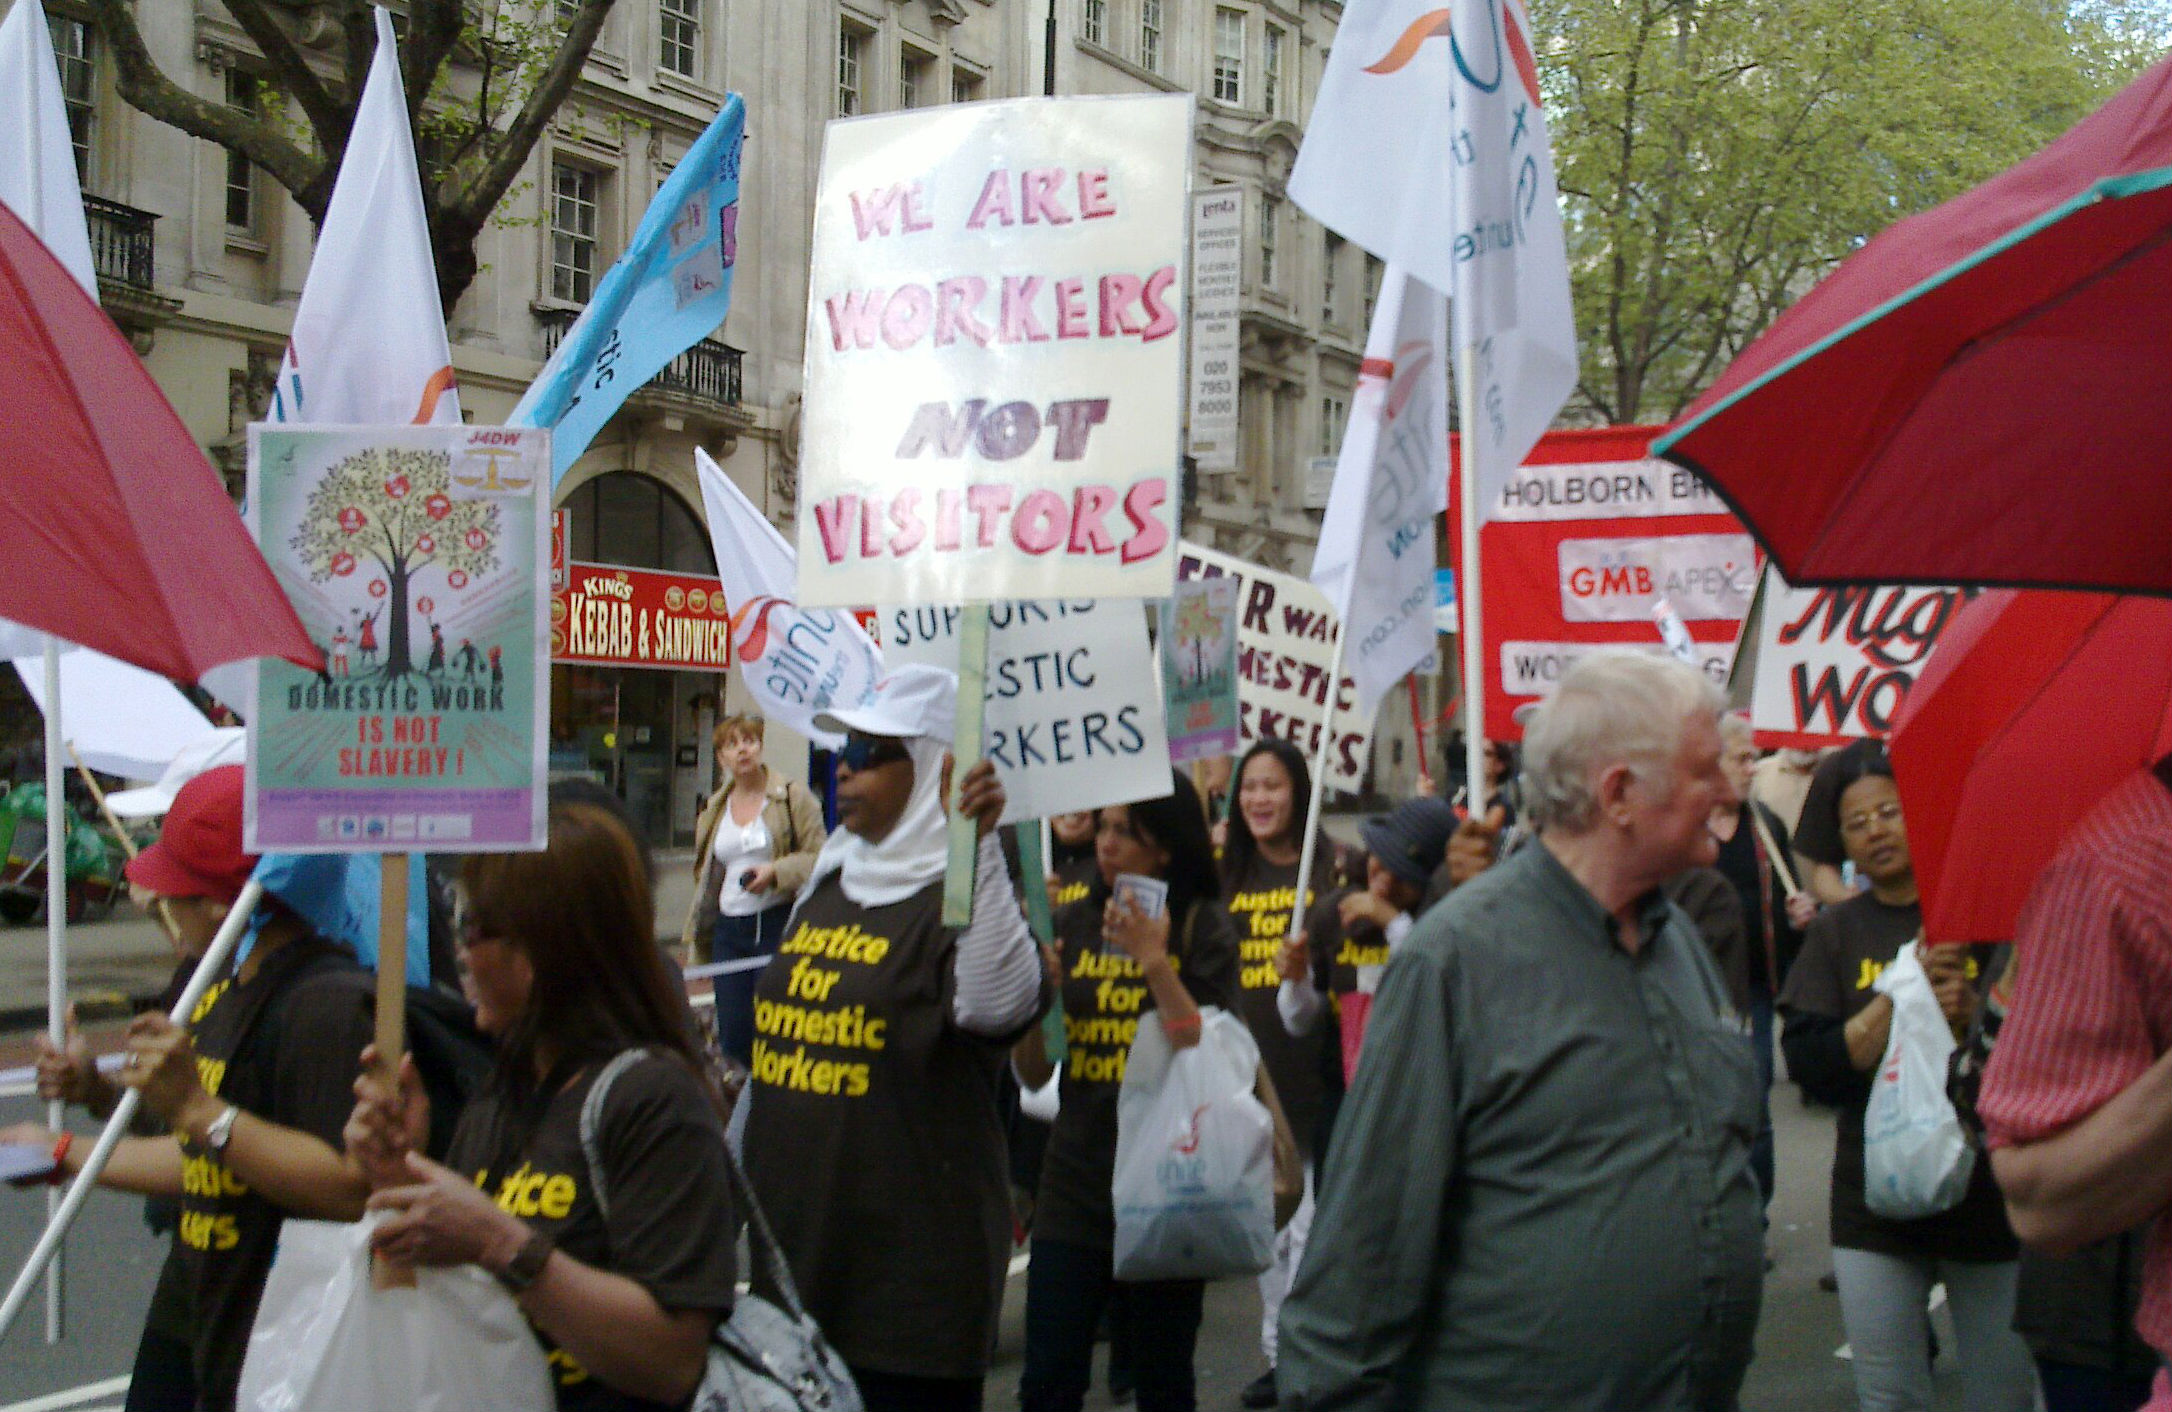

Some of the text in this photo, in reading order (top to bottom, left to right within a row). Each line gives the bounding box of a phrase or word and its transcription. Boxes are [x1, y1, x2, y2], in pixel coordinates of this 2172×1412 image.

[849, 168, 1117, 241] WE ARE
[825, 266, 1179, 352] WORKERS
[895, 398, 1110, 462] NOT
[1502, 474, 1653, 506] HOLBORN
[814, 479, 1168, 566] VISITORS
[1571, 566, 1653, 598] GMB
[569, 592, 728, 664] KEBAB & SANDWICH
[1283, 604, 1341, 647] WA
[984, 647, 1096, 700] STIC
[358, 715, 443, 744] IS NOT
[338, 747, 449, 777] SLAVERY
[1250, 911, 1291, 937] for
[786, 955, 842, 1002] for
[1096, 979, 1148, 1013] for
[753, 995, 888, 1051] omestic
